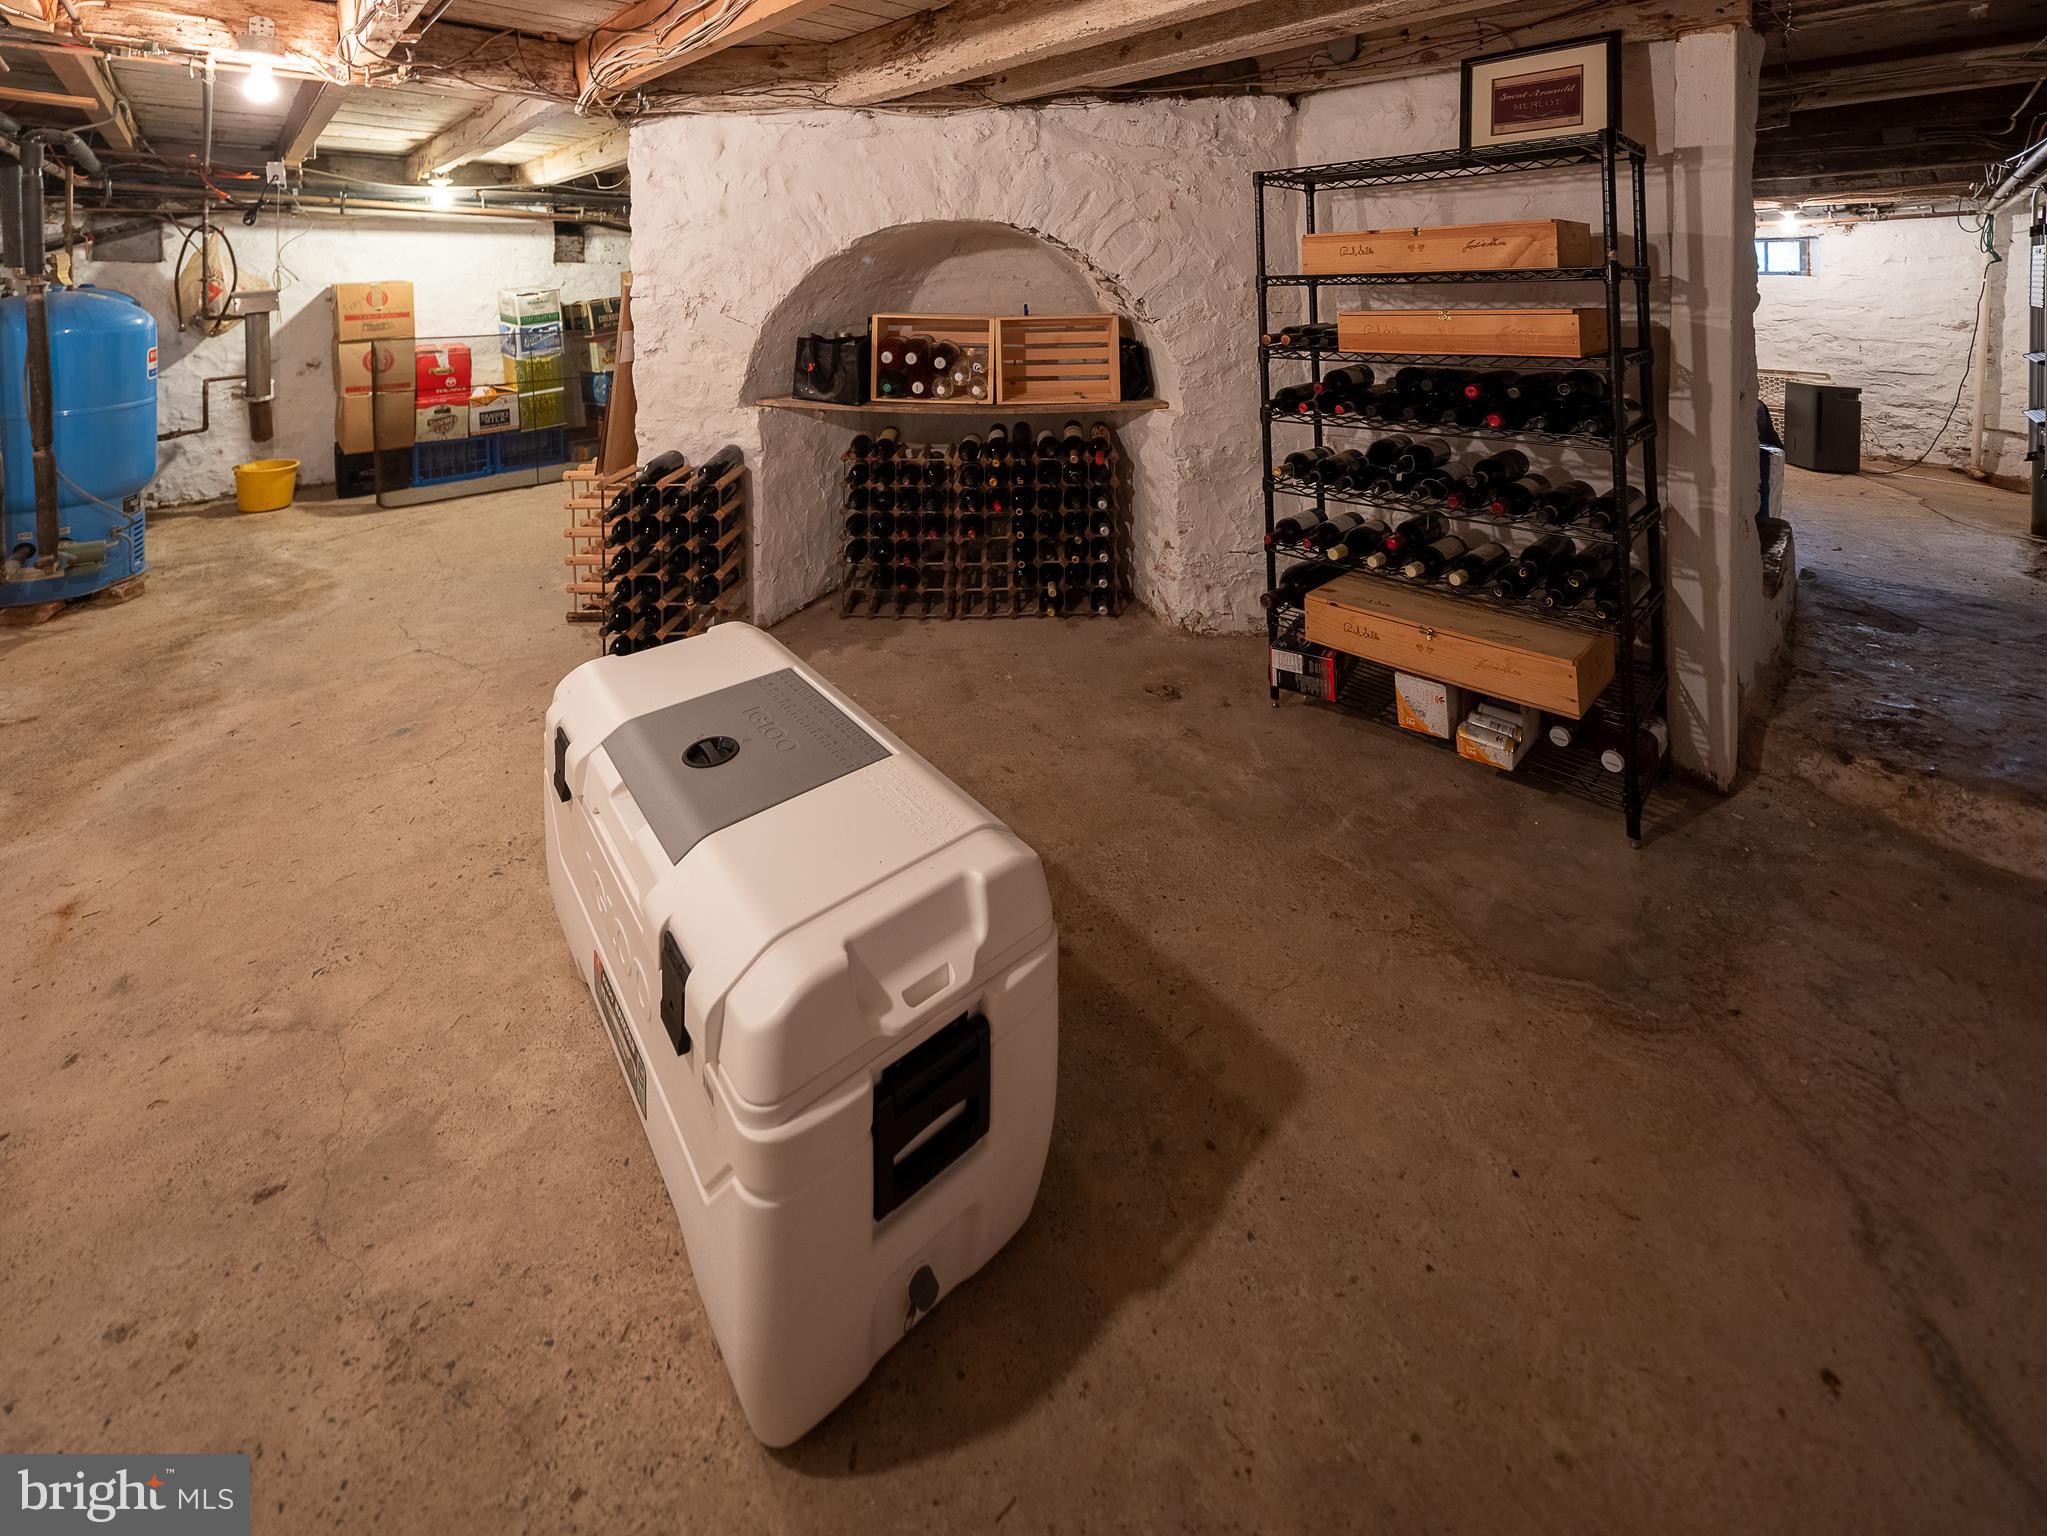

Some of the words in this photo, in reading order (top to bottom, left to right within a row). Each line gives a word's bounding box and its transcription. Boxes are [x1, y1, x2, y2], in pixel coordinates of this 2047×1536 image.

[1498, 91, 1527, 101] Saint
[1513, 98, 1560, 110] MERLOT
[742, 705, 799, 753] IGLOO
